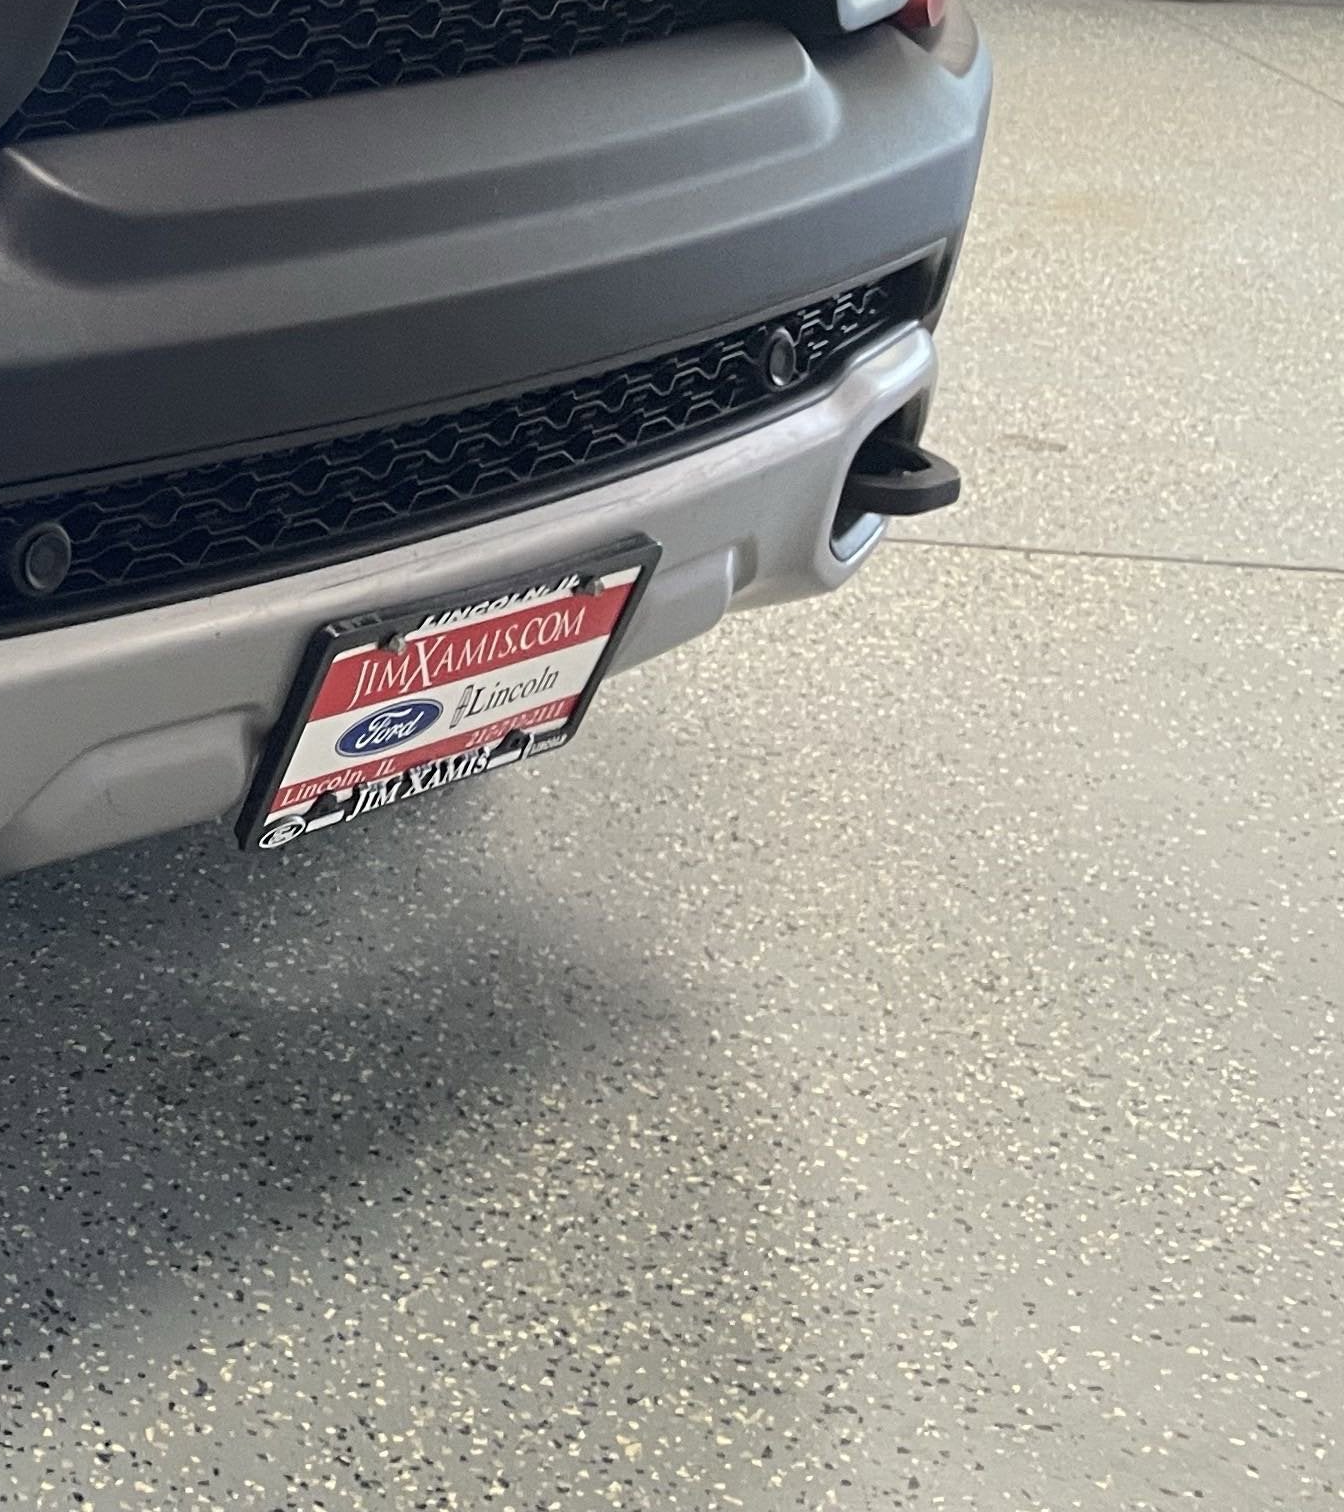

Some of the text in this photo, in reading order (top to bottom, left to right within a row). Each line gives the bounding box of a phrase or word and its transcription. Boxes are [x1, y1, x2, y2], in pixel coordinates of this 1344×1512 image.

[348, 605, 587, 710] JIMXAMIS.COM
[464, 665, 561, 718] Lincoln
[355, 707, 419, 750] Ford
[345, 752, 491, 822] JIM XAMIS
[375, 757, 397, 780] IL
